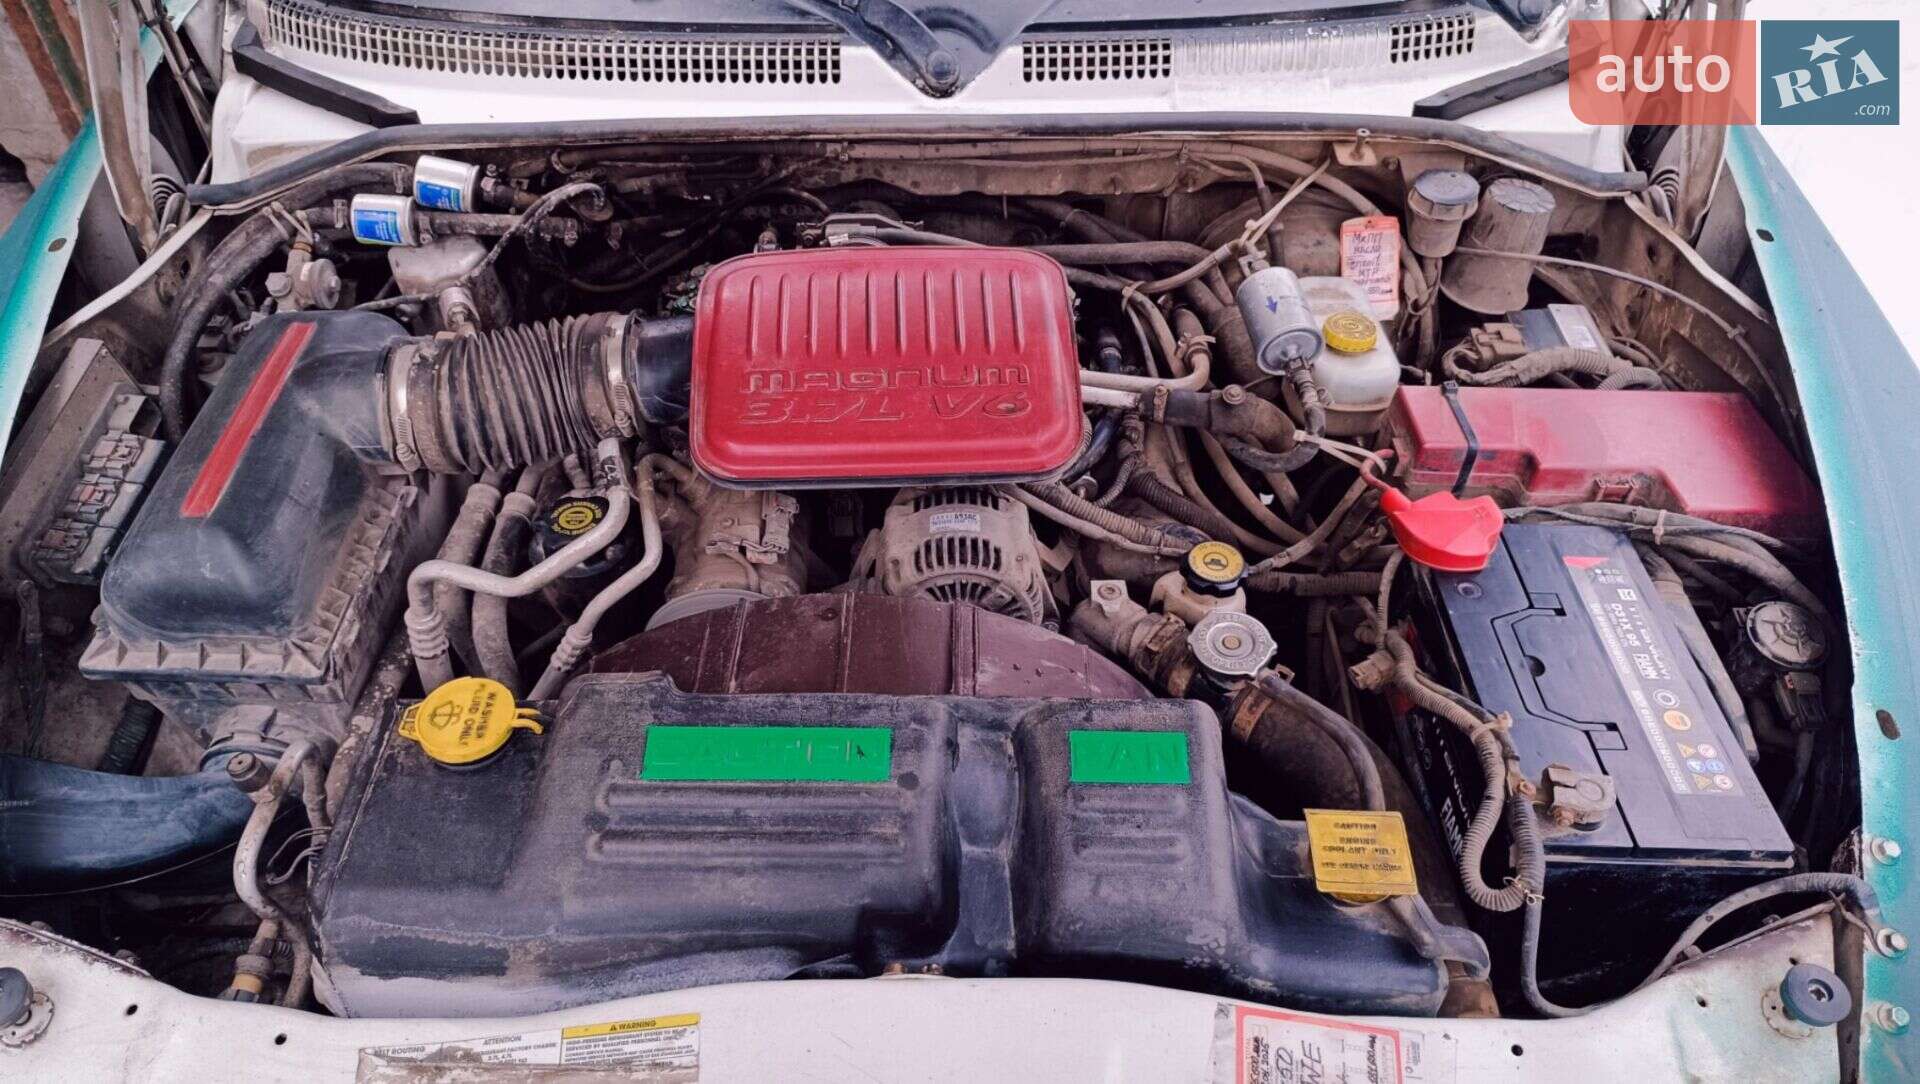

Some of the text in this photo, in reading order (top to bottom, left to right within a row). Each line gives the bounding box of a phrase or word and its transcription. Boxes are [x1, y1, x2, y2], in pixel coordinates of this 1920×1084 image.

[741, 363, 1030, 393] MAGNUM
[930, 393, 1032, 419] V6
[1333, 822, 1377, 830] CAUTION
[1441, 797, 1464, 857] FIAM
[619, 1020, 656, 1030] WARNING
